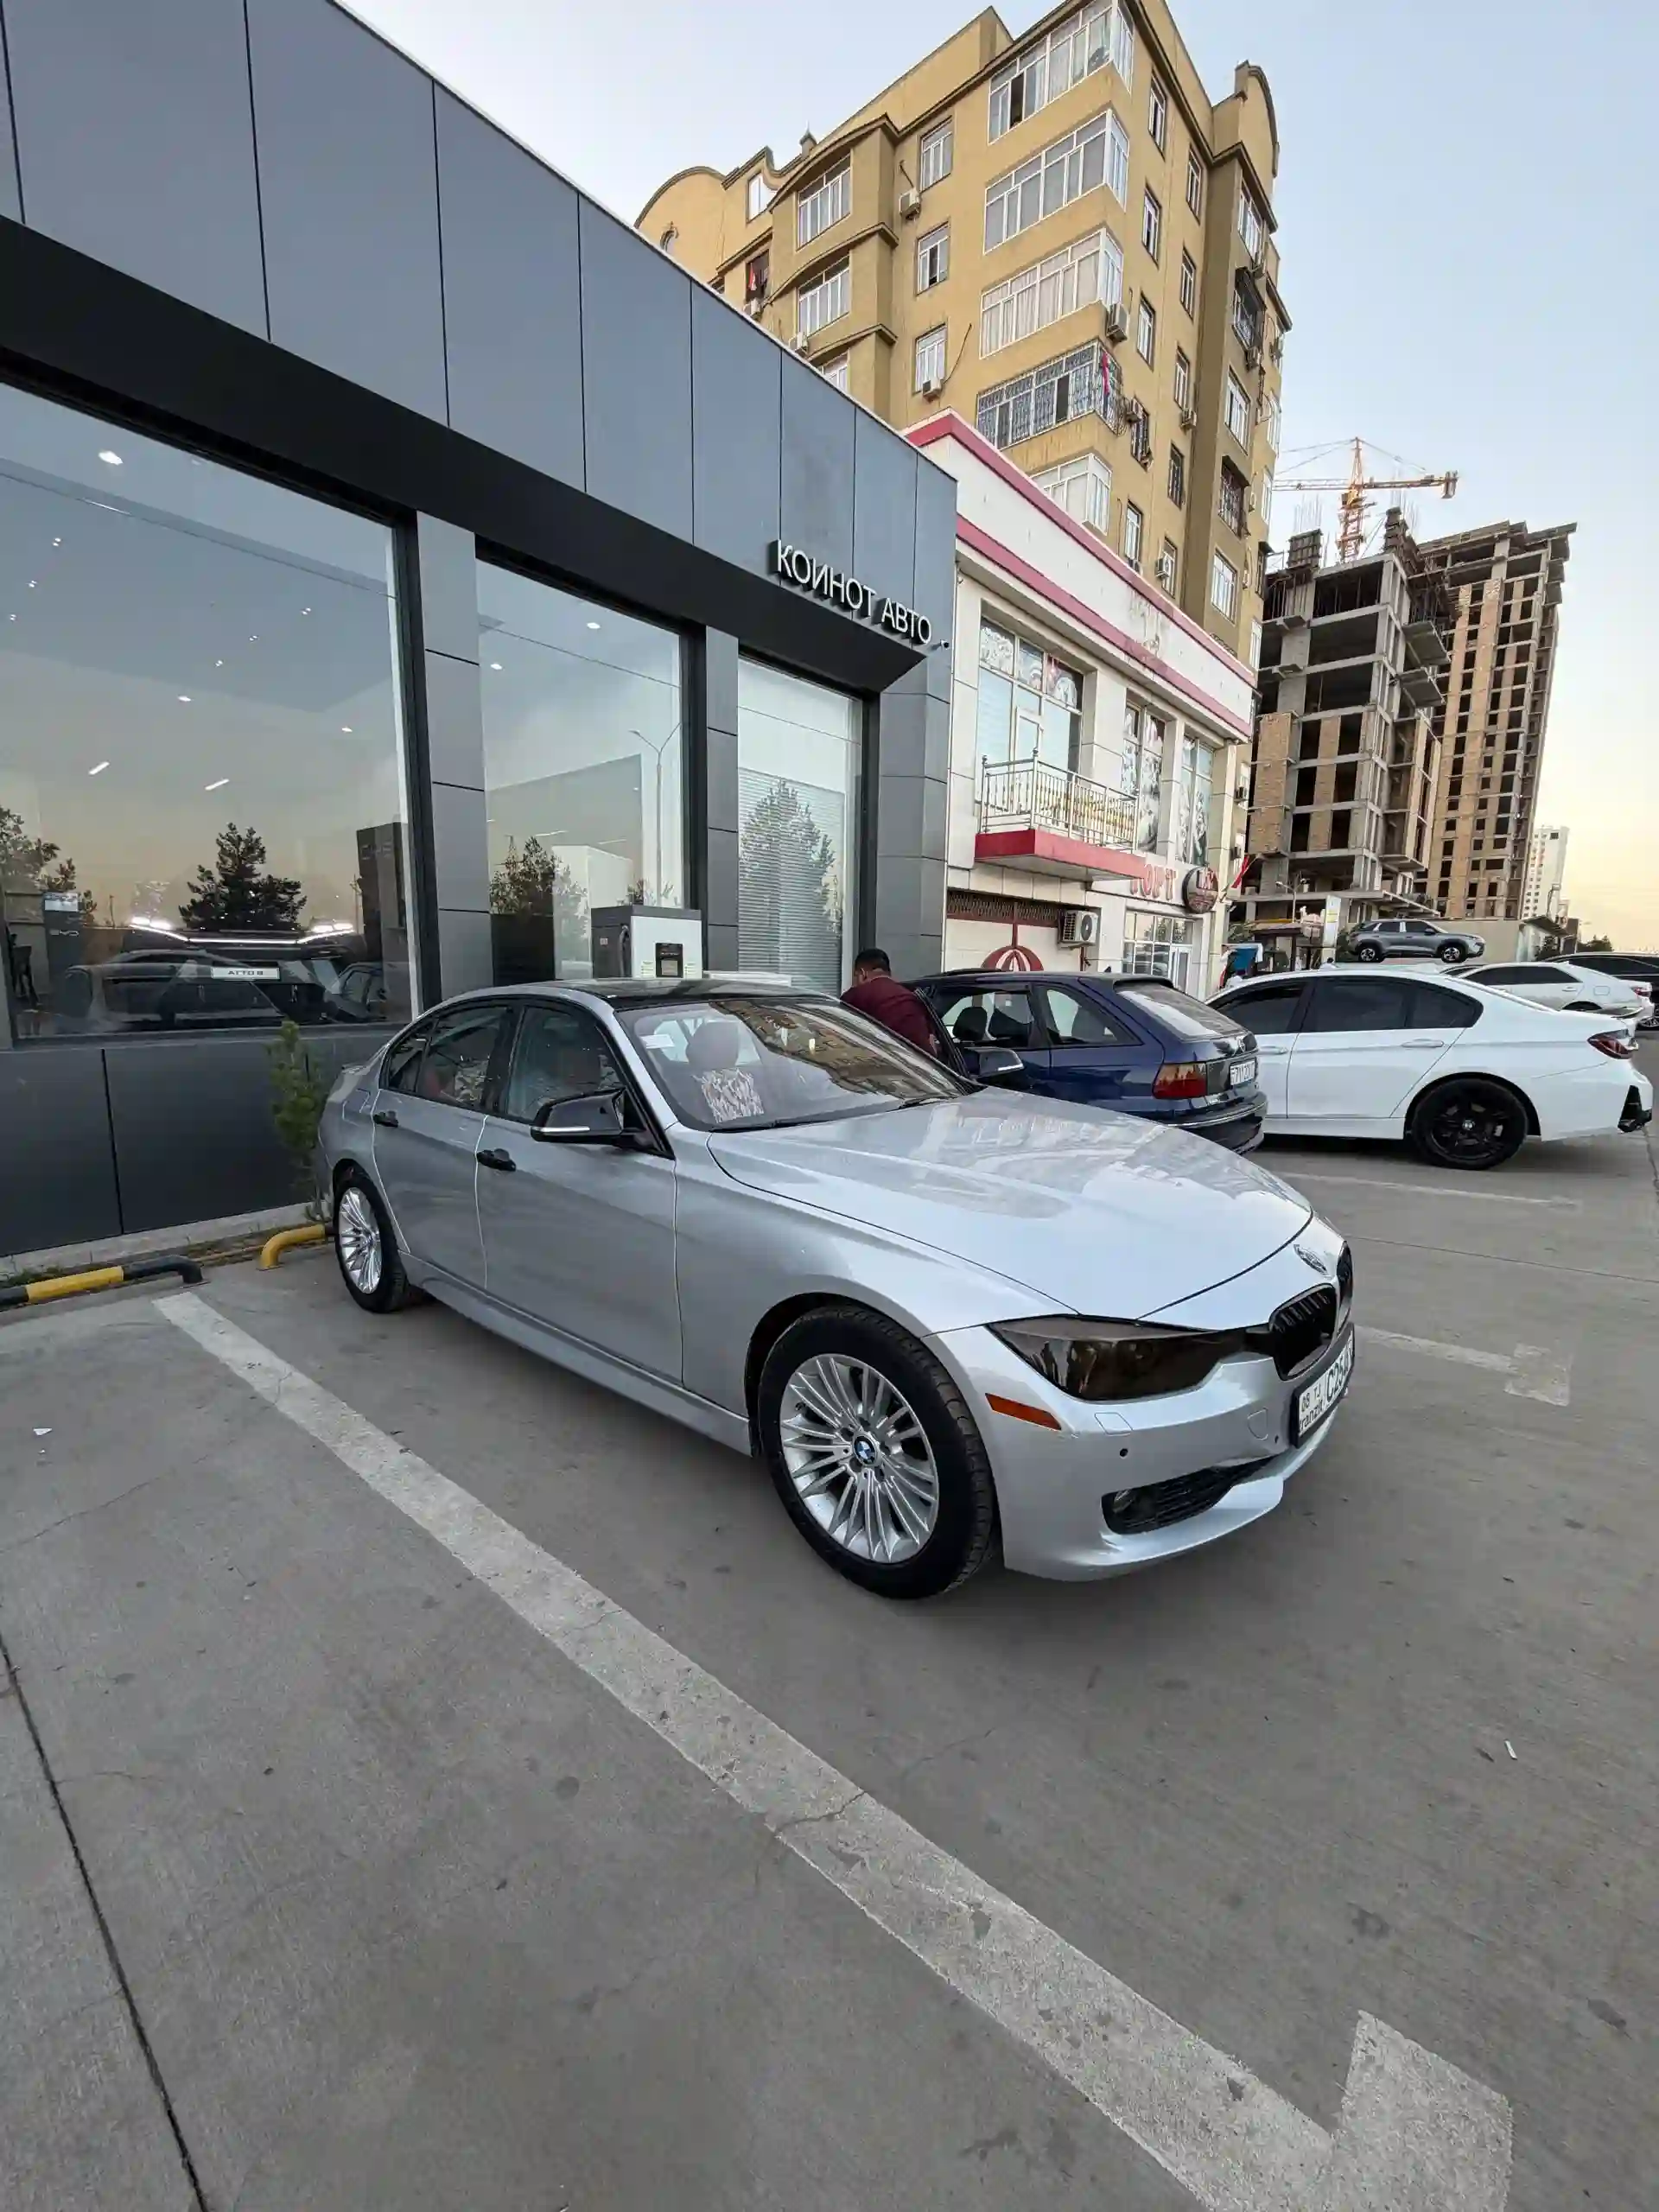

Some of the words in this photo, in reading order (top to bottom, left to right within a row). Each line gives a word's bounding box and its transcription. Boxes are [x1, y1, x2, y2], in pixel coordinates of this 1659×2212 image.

[777, 539, 877, 619] КОИНОТ
[881, 597, 931, 644] АВТО
[1313, 1382, 1321, 1400] TJ
